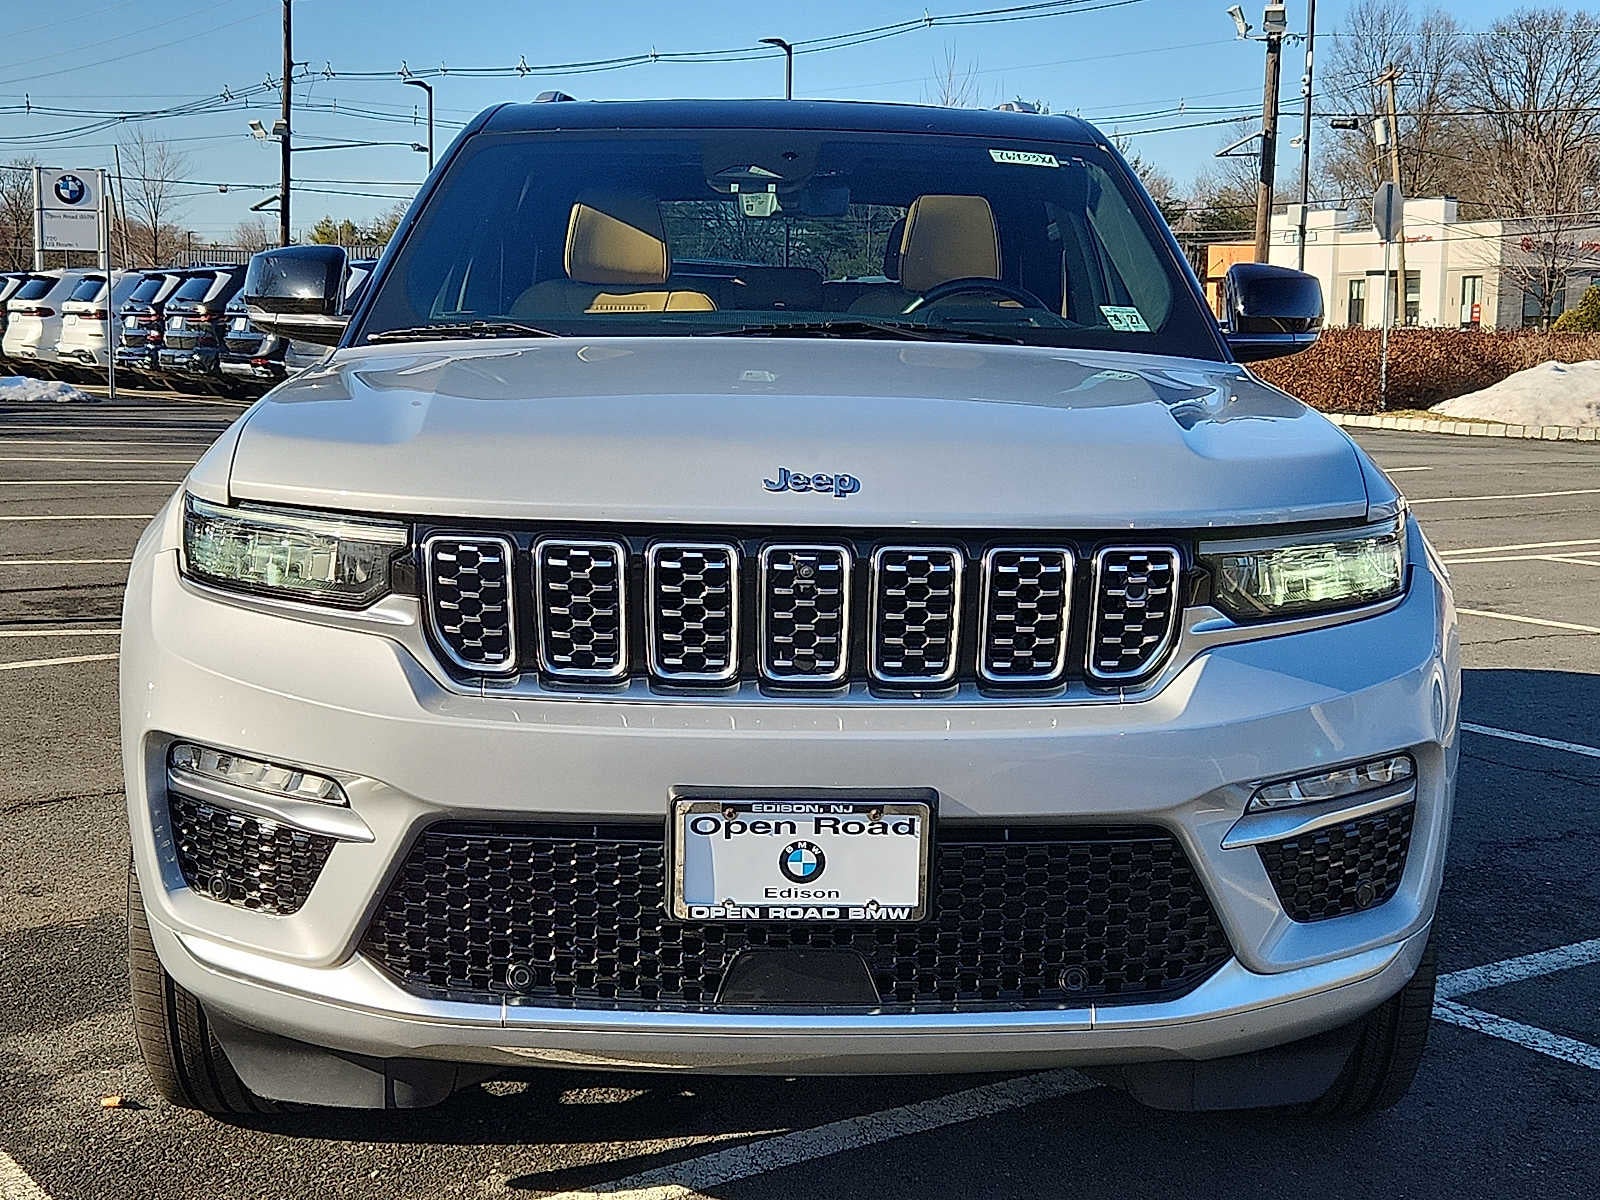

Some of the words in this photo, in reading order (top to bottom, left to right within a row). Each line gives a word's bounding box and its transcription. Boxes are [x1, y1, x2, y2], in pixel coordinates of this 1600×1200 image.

[763, 466, 861, 498] Jeep
[751, 803, 824, 814] EDISON,
[830, 804, 854, 814] NJ
[690, 816, 797, 839] Open
[813, 817, 916, 836] Road
[785, 841, 822, 855] BMW
[764, 887, 840, 899] Edison
[691, 907, 760, 920] OPEN
[768, 906, 840, 920] ROAD
[850, 907, 911, 920] BMW
